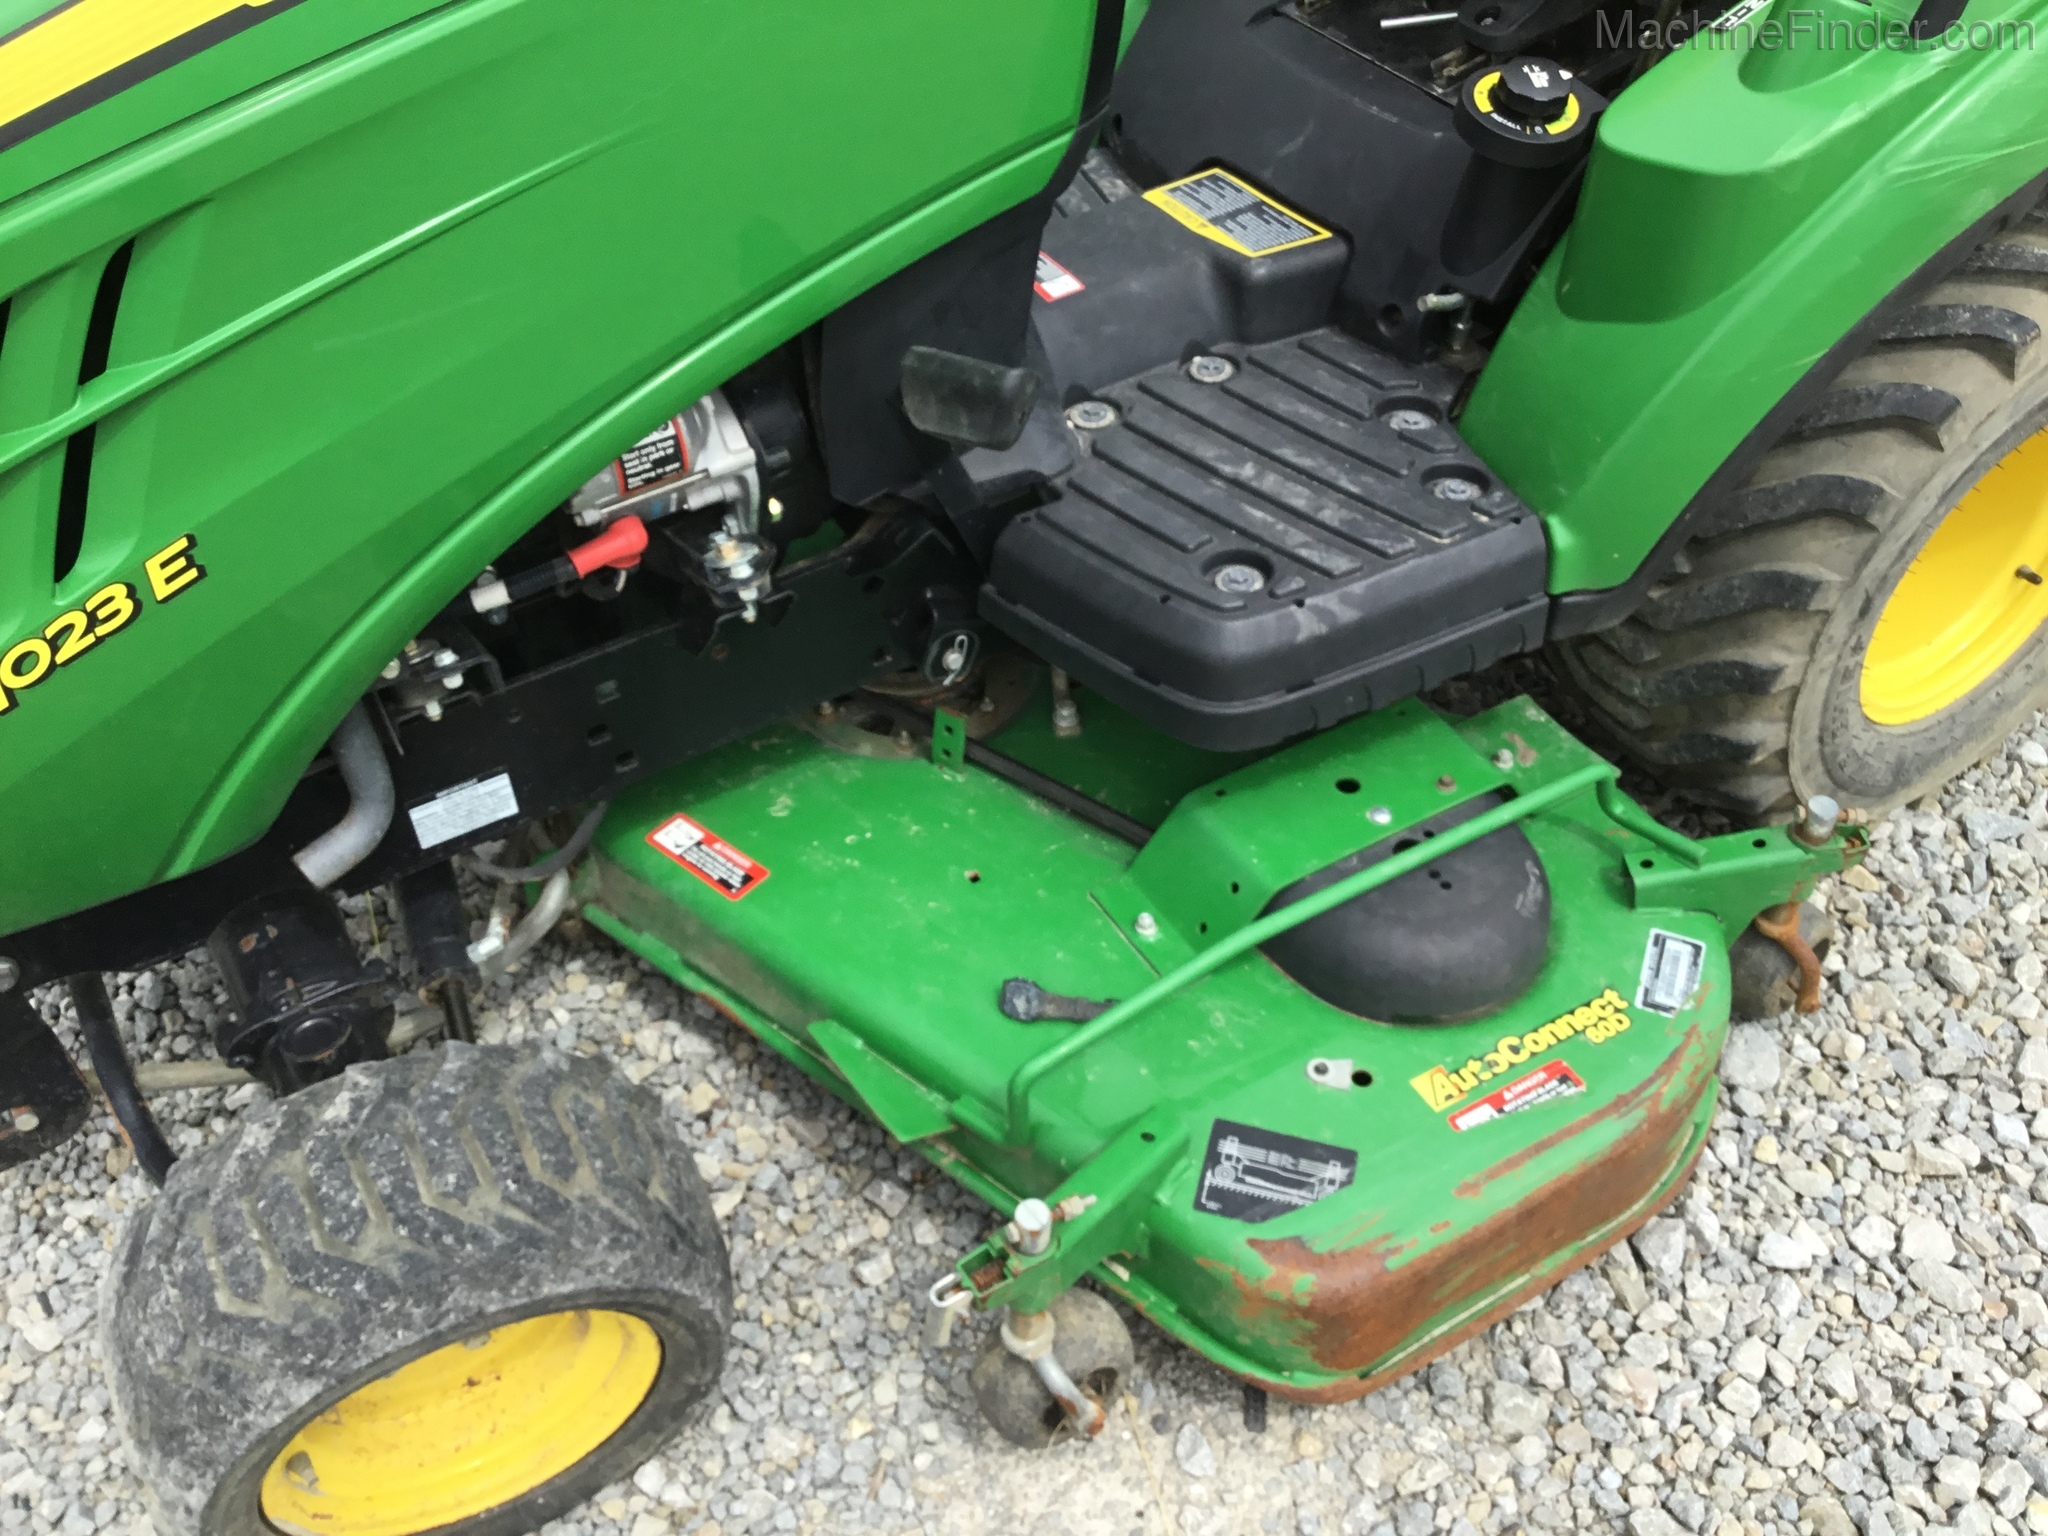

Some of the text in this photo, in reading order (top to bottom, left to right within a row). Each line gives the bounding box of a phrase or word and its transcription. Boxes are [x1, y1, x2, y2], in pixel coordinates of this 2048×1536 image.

[145, 534, 207, 604] E
[1430, 988, 1630, 1107] AutoConnect
[1511, 1070, 1548, 1096] DANGER
